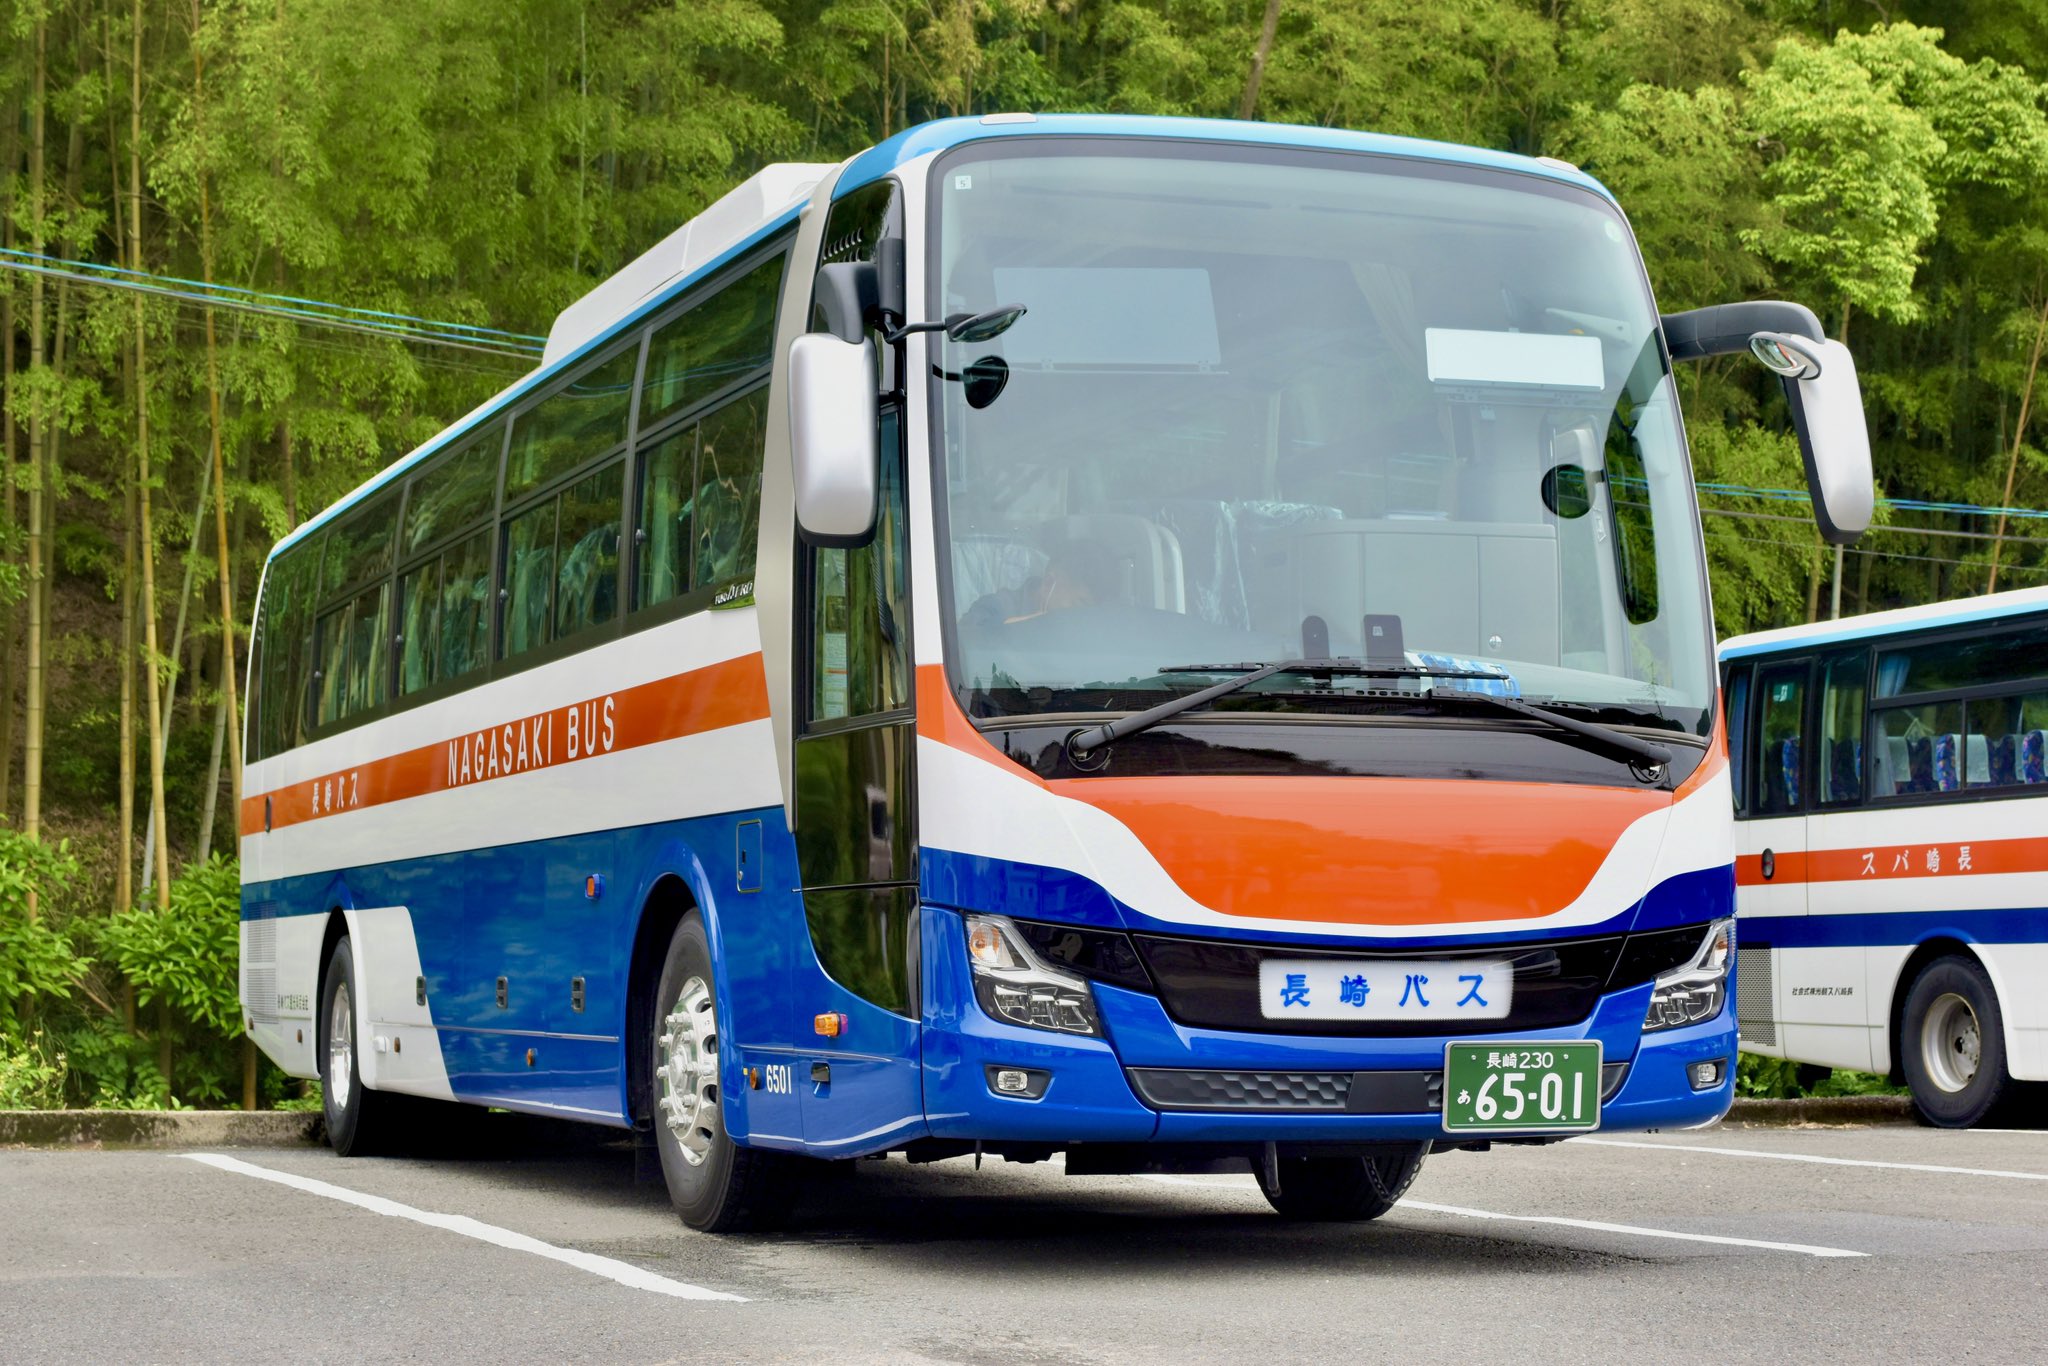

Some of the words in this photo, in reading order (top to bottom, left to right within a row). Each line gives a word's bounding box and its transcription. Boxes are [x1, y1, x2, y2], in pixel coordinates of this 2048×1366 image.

[448, 713, 552, 786] NAGASAKI
[567, 696, 615, 759] BUS
[1280, 973, 1488, 1008] 長崎バス
[1486, 1052, 1554, 1069] 長崎230
[766, 1064, 792, 1094] 6501
[1457, 1089, 1471, 1105] あ
[1475, 1072, 1583, 1121] 65-01
